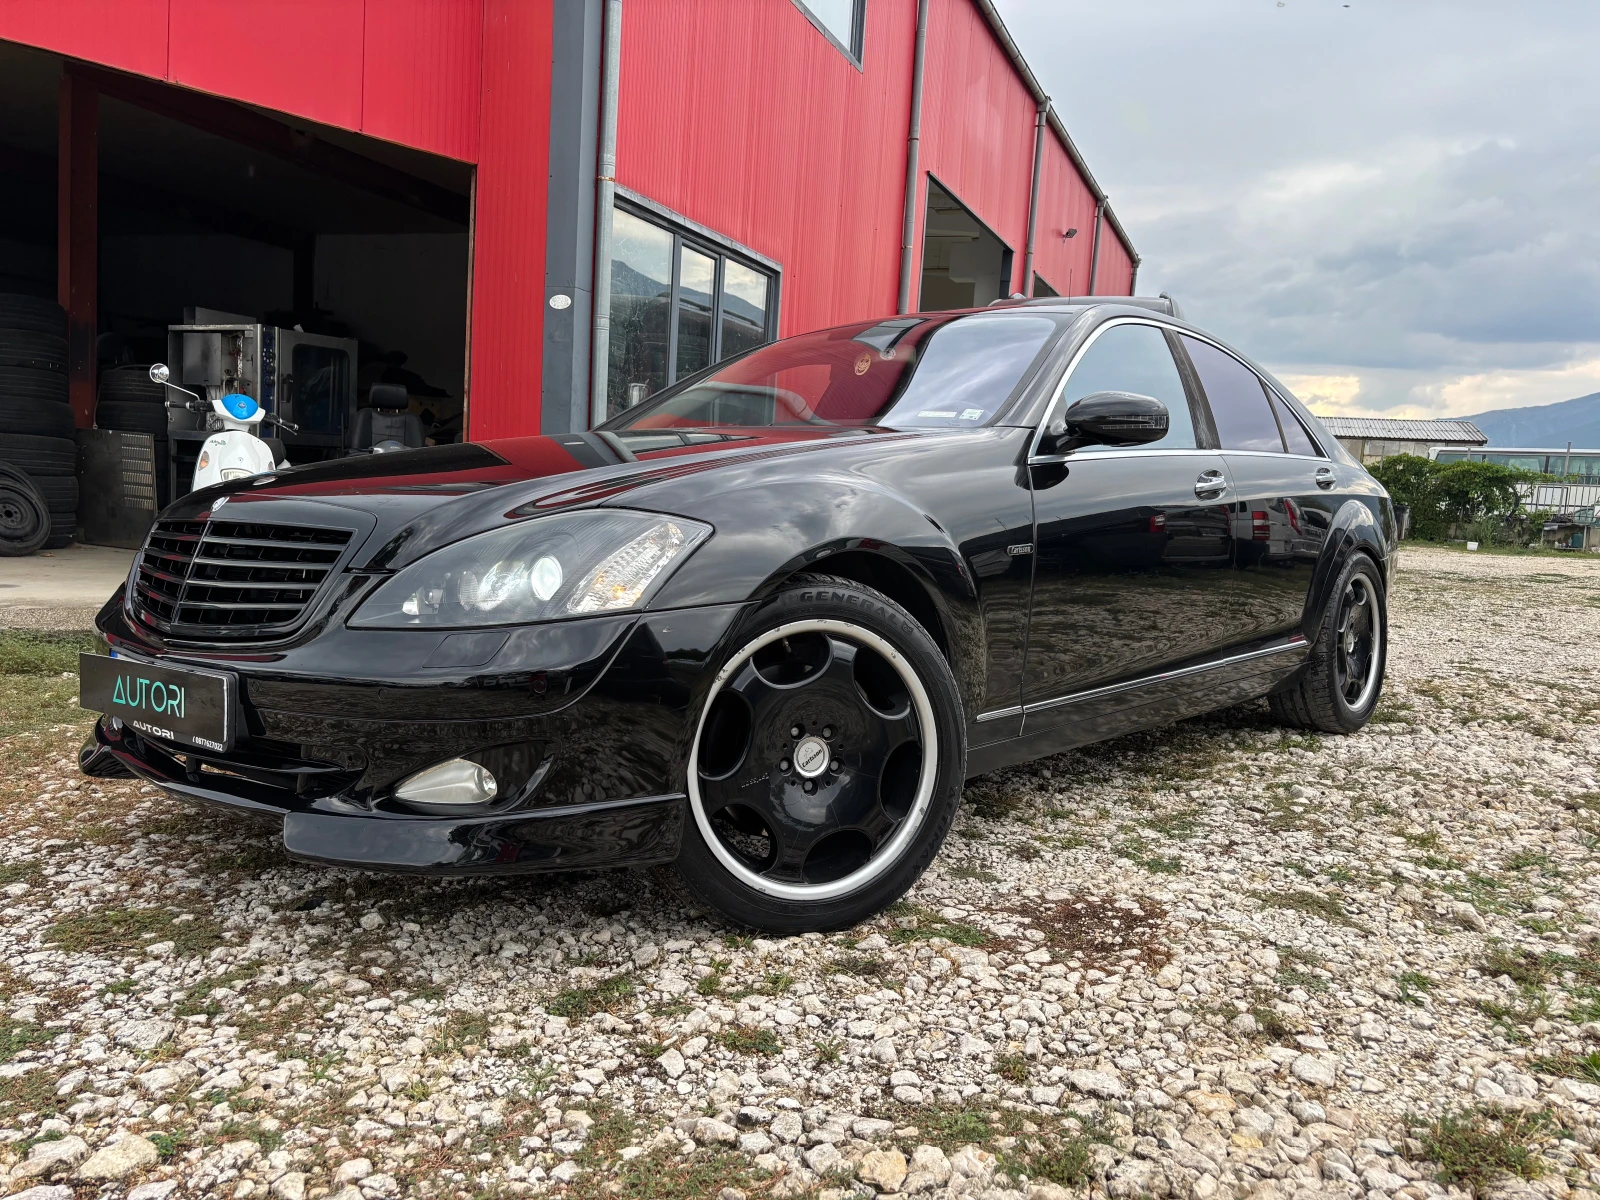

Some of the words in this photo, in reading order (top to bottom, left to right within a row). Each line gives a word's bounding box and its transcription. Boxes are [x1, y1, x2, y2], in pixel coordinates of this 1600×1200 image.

[799, 591, 898, 626] GENERAL
[113, 674, 185, 718] AUTORI
[132, 720, 175, 740] AUTORI
[801, 748, 822, 768] Carlsson
